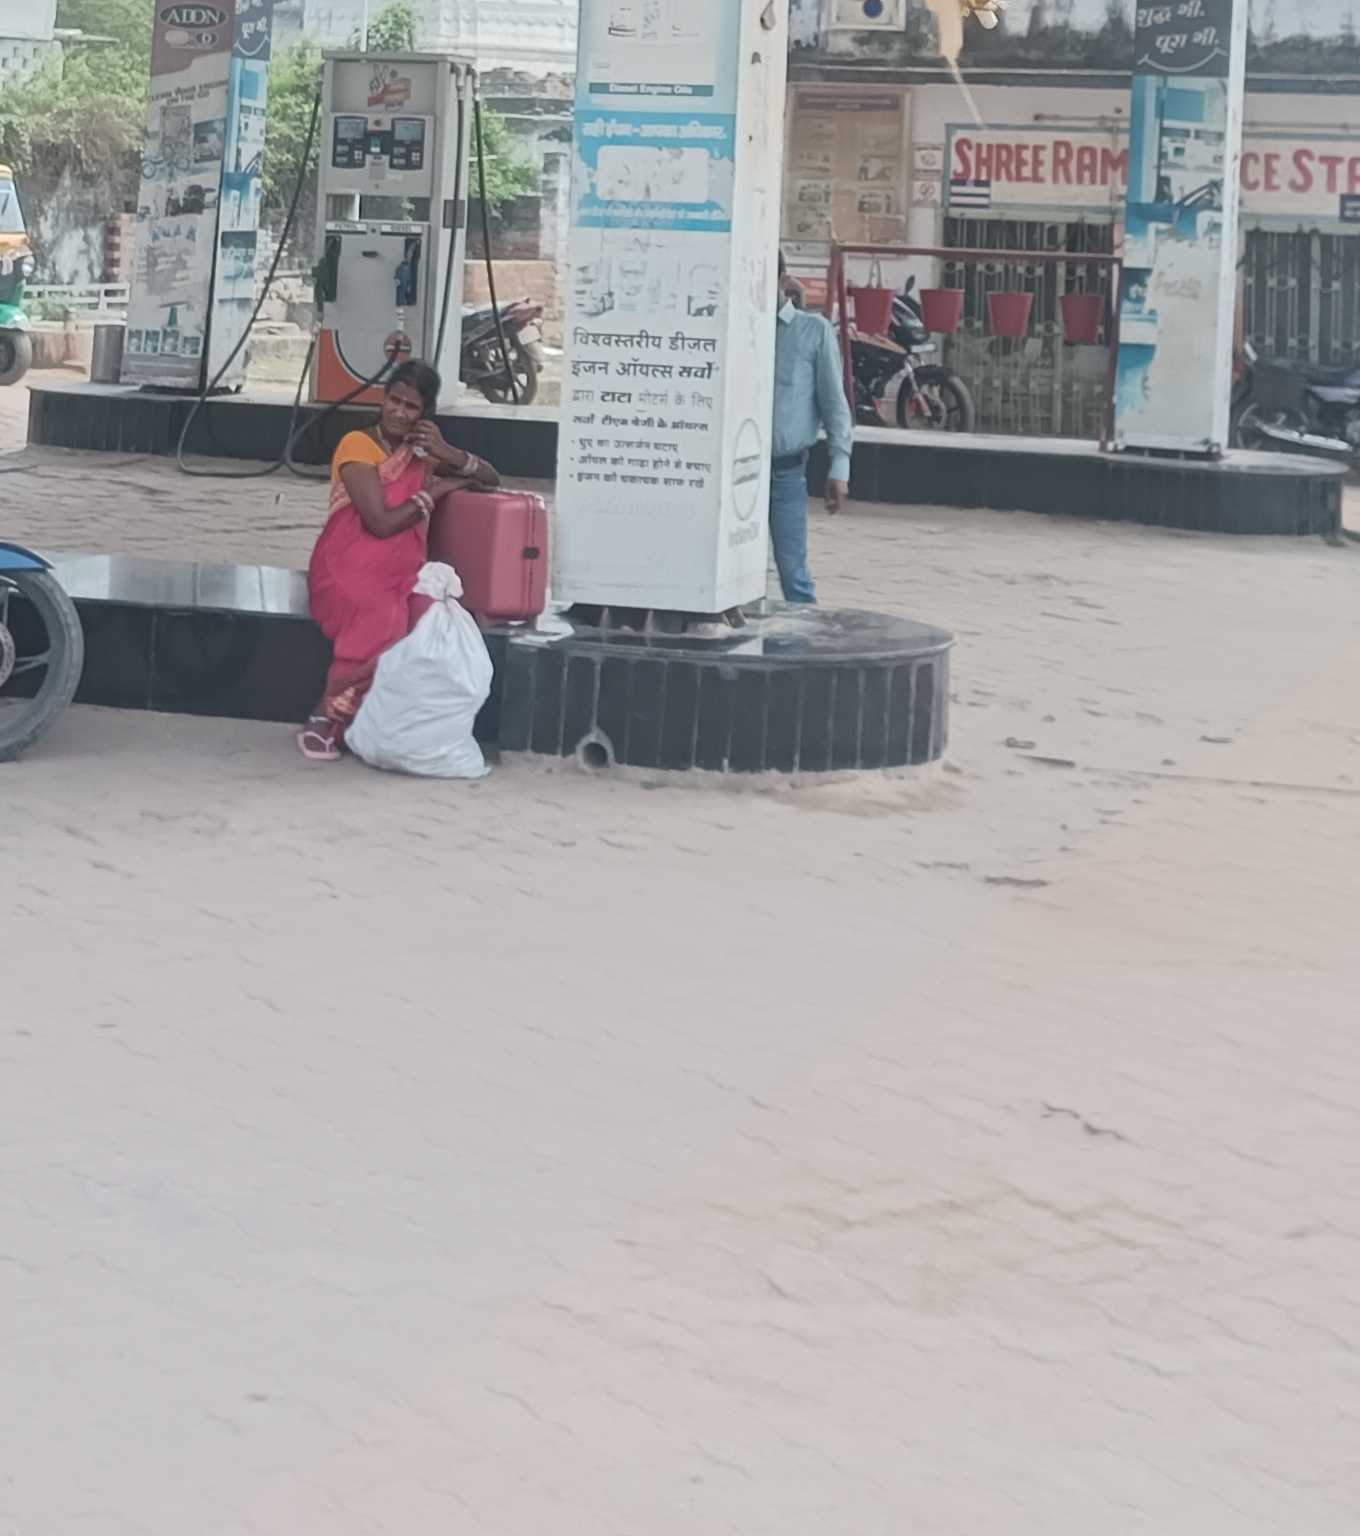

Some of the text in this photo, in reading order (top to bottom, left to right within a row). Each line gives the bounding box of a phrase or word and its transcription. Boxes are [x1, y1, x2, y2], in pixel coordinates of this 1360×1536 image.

[1156, 33, 1188, 54] पूरा
[640, 83, 672, 96] Engine
[952, 137, 1047, 185] SHREE
[1052, 139, 1131, 187] RAM
[573, 326, 717, 354] विश्वस्तरीय डीज़ल
[571, 355, 609, 376] इंजन
[616, 358, 673, 378] ऑयल्स
[572, 389, 595, 402] द्वारा
[600, 391, 632, 404] टाटा
[674, 390, 686, 406] के
[692, 390, 713, 409] लिए
[657, 416, 668, 429] के
[610, 454, 624, 466] को
[652, 456, 671, 470] होने
[603, 471, 617, 483] को
